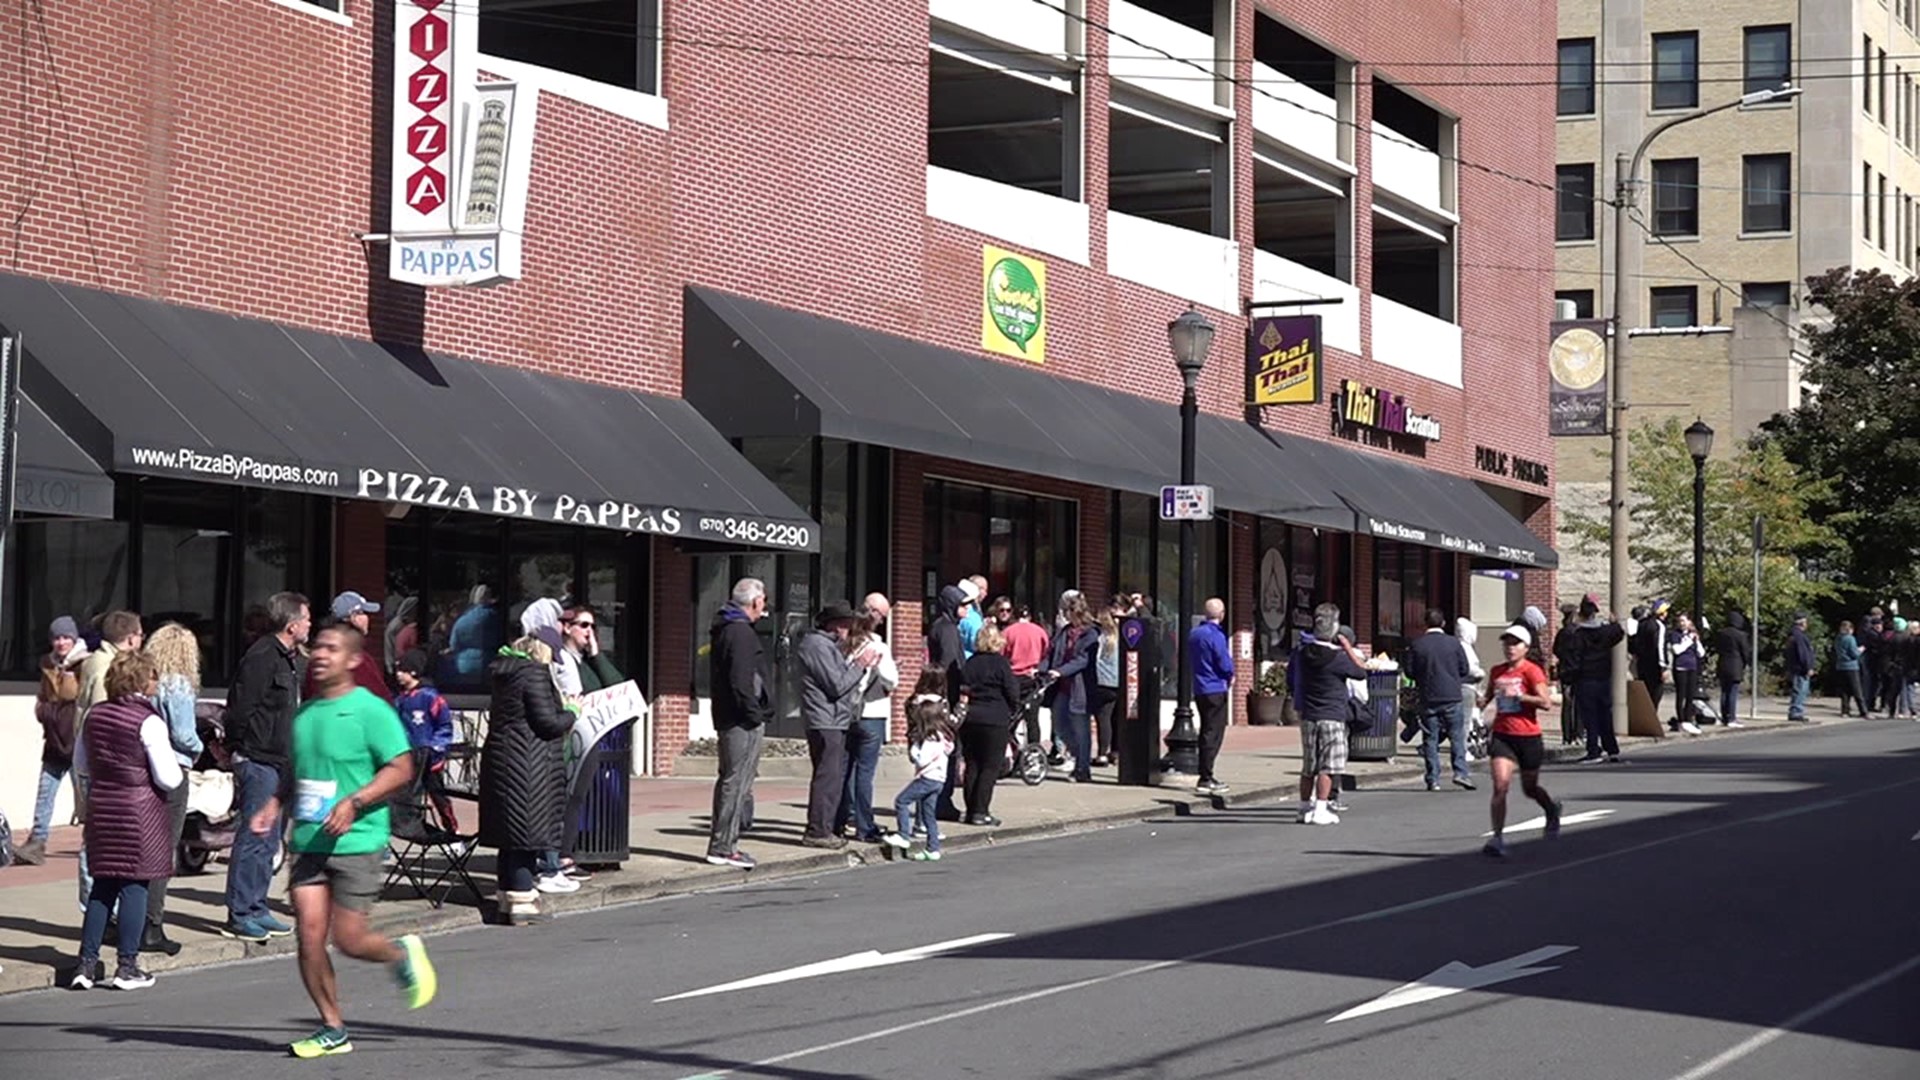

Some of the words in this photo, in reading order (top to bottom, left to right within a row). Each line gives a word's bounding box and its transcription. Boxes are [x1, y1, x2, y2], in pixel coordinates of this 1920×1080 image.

[409, 24, 442, 205] IZZA
[401, 247, 493, 275] PAPPAS
[1260, 338, 1309, 370] Thai
[1260, 356, 1309, 389] Thai
[1345, 380, 1375, 426] Thai
[1377, 390, 1406, 434] Thai
[132, 447, 339, 488] www.PizzaByPappas.com
[1476, 445, 1508, 476] PUBLIC
[1512, 455, 1548, 487] PARKING
[357, 468, 480, 509] PIZZA
[492, 486, 536, 517] BY
[553, 494, 682, 535] PAPPAS
[699, 517, 725, 533] (570)
[724, 517, 809, 547] 346-2290
[1127, 652, 1138, 675] PAY
